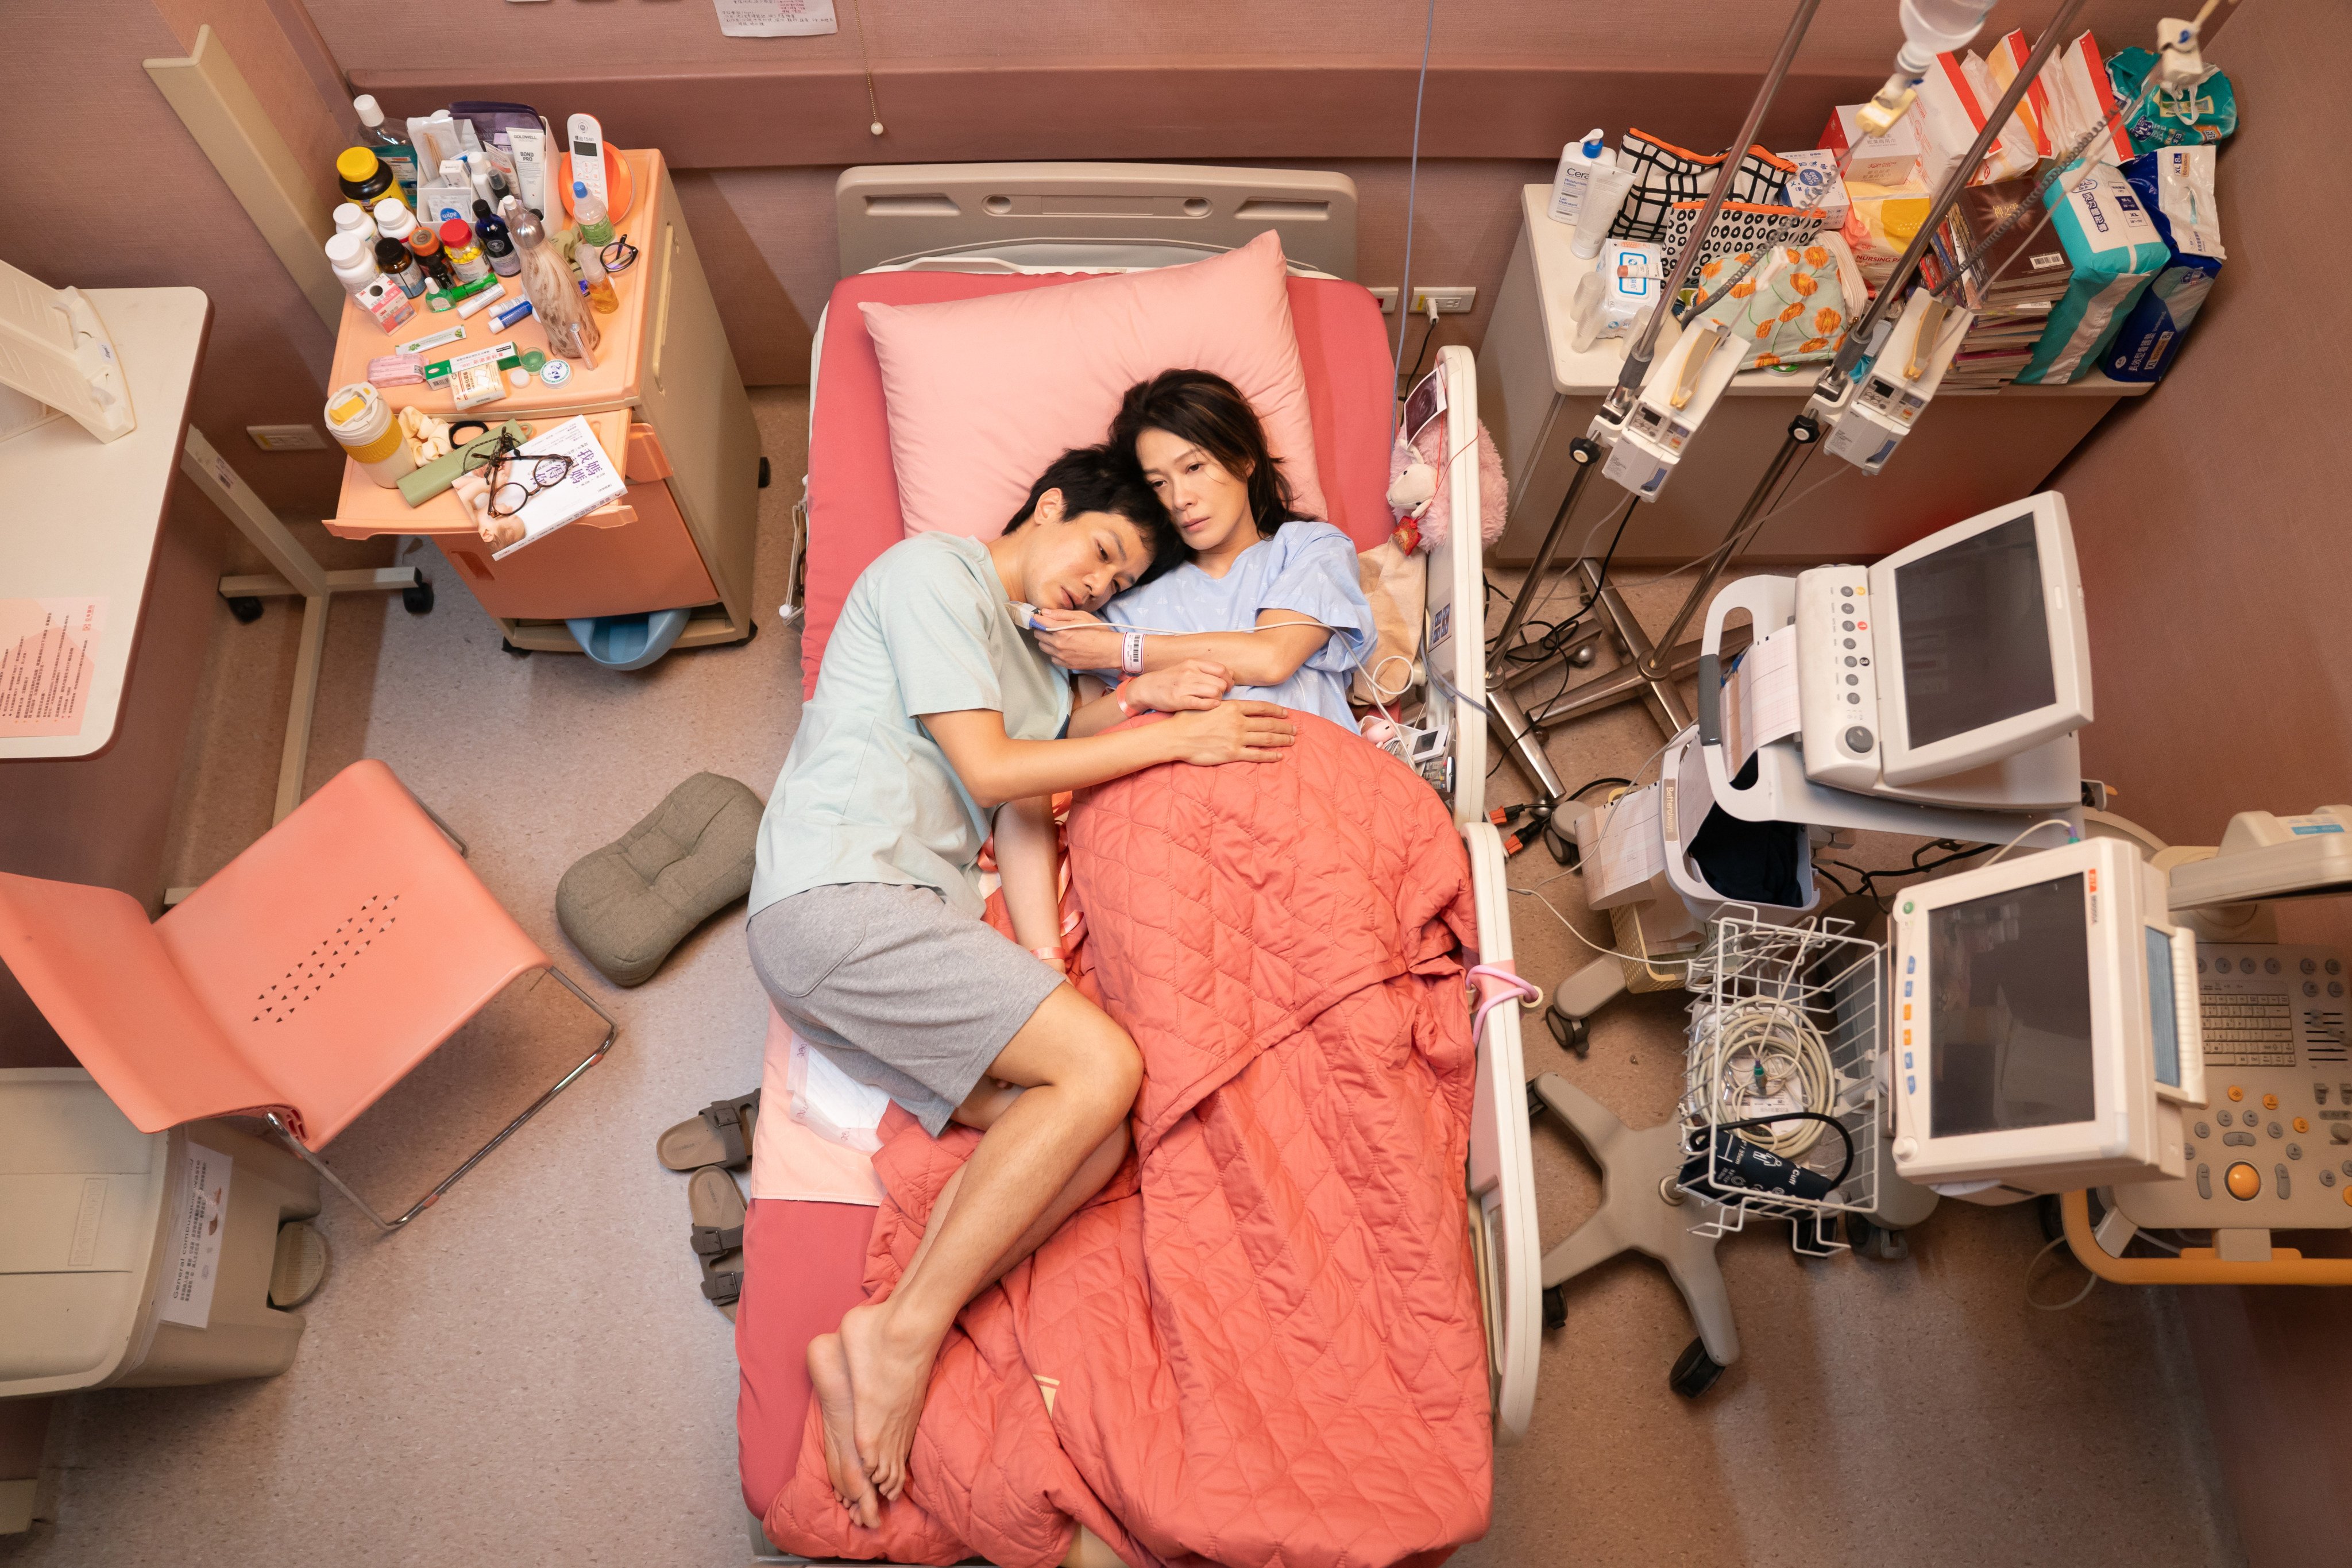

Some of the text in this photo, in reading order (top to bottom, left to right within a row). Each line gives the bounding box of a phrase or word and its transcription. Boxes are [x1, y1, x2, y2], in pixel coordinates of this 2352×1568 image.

[1567, 168, 1589, 179] Cera
[2175, 165, 2181, 174] XL
[1666, 787, 1674, 833] Betteralways
[1789, 1169, 1800, 1185] Cuff
[173, 1258, 185, 1299] General
